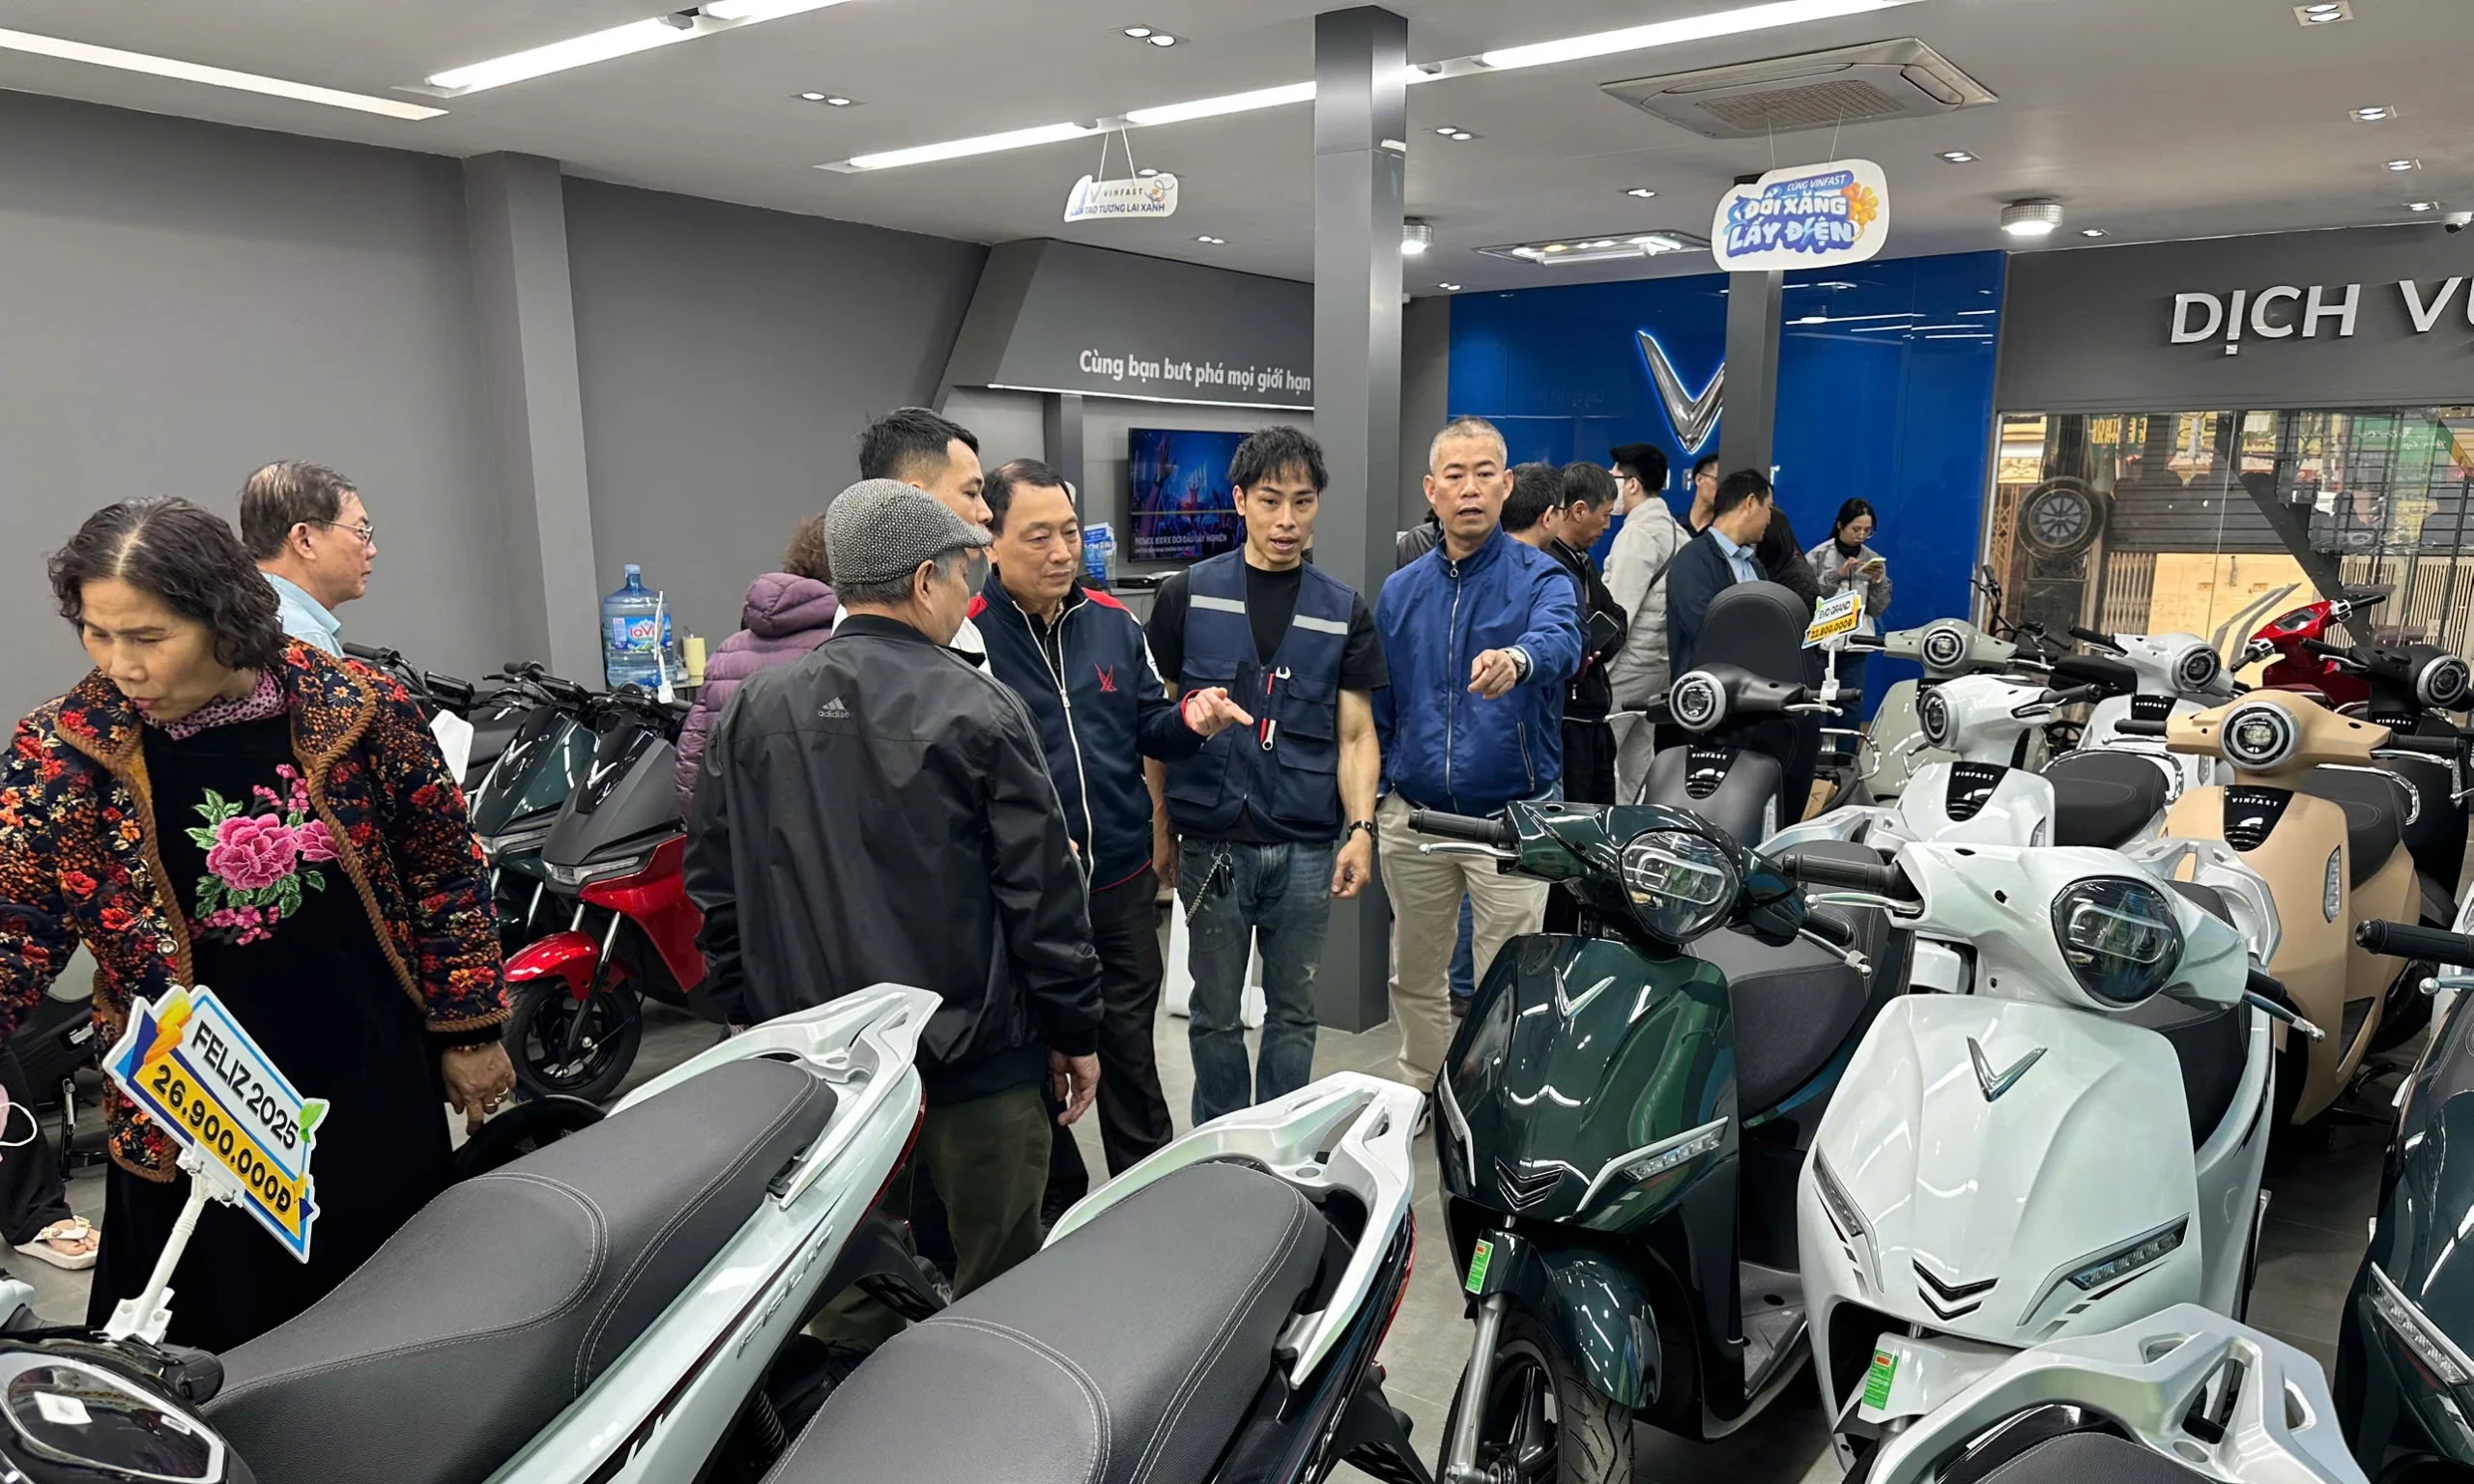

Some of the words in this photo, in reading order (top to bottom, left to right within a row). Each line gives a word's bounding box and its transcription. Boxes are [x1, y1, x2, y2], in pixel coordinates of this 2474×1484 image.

[1809, 174, 1847, 188] VINFAST
[1104, 187, 1143, 197] VINFAST
[1127, 203, 1139, 213] LAI
[1140, 203, 1165, 213] XANH
[1783, 190, 1847, 215] XĂNG
[1729, 216, 1781, 251] LẤY
[2171, 283, 2361, 356] DỊCH
[2399, 276, 2474, 333] V
[1079, 349, 1124, 382] Cùng
[1128, 354, 1160, 384] bạn
[1194, 361, 1224, 387] phá
[1227, 365, 1254, 391] mọi
[1257, 367, 1283, 393] giới
[1286, 370, 1311, 395] hạn
[2135, 700, 2168, 710] VINFAST
[1691, 752, 1727, 760] VINFAST
[1955, 770, 1995, 781] VINFAST
[2231, 797, 2279, 808] VINFAST
[190, 1019, 252, 1100] FELIZ
[245, 1081, 300, 1151] 2025
[151, 1063, 292, 1214] 26.900.000Đ
